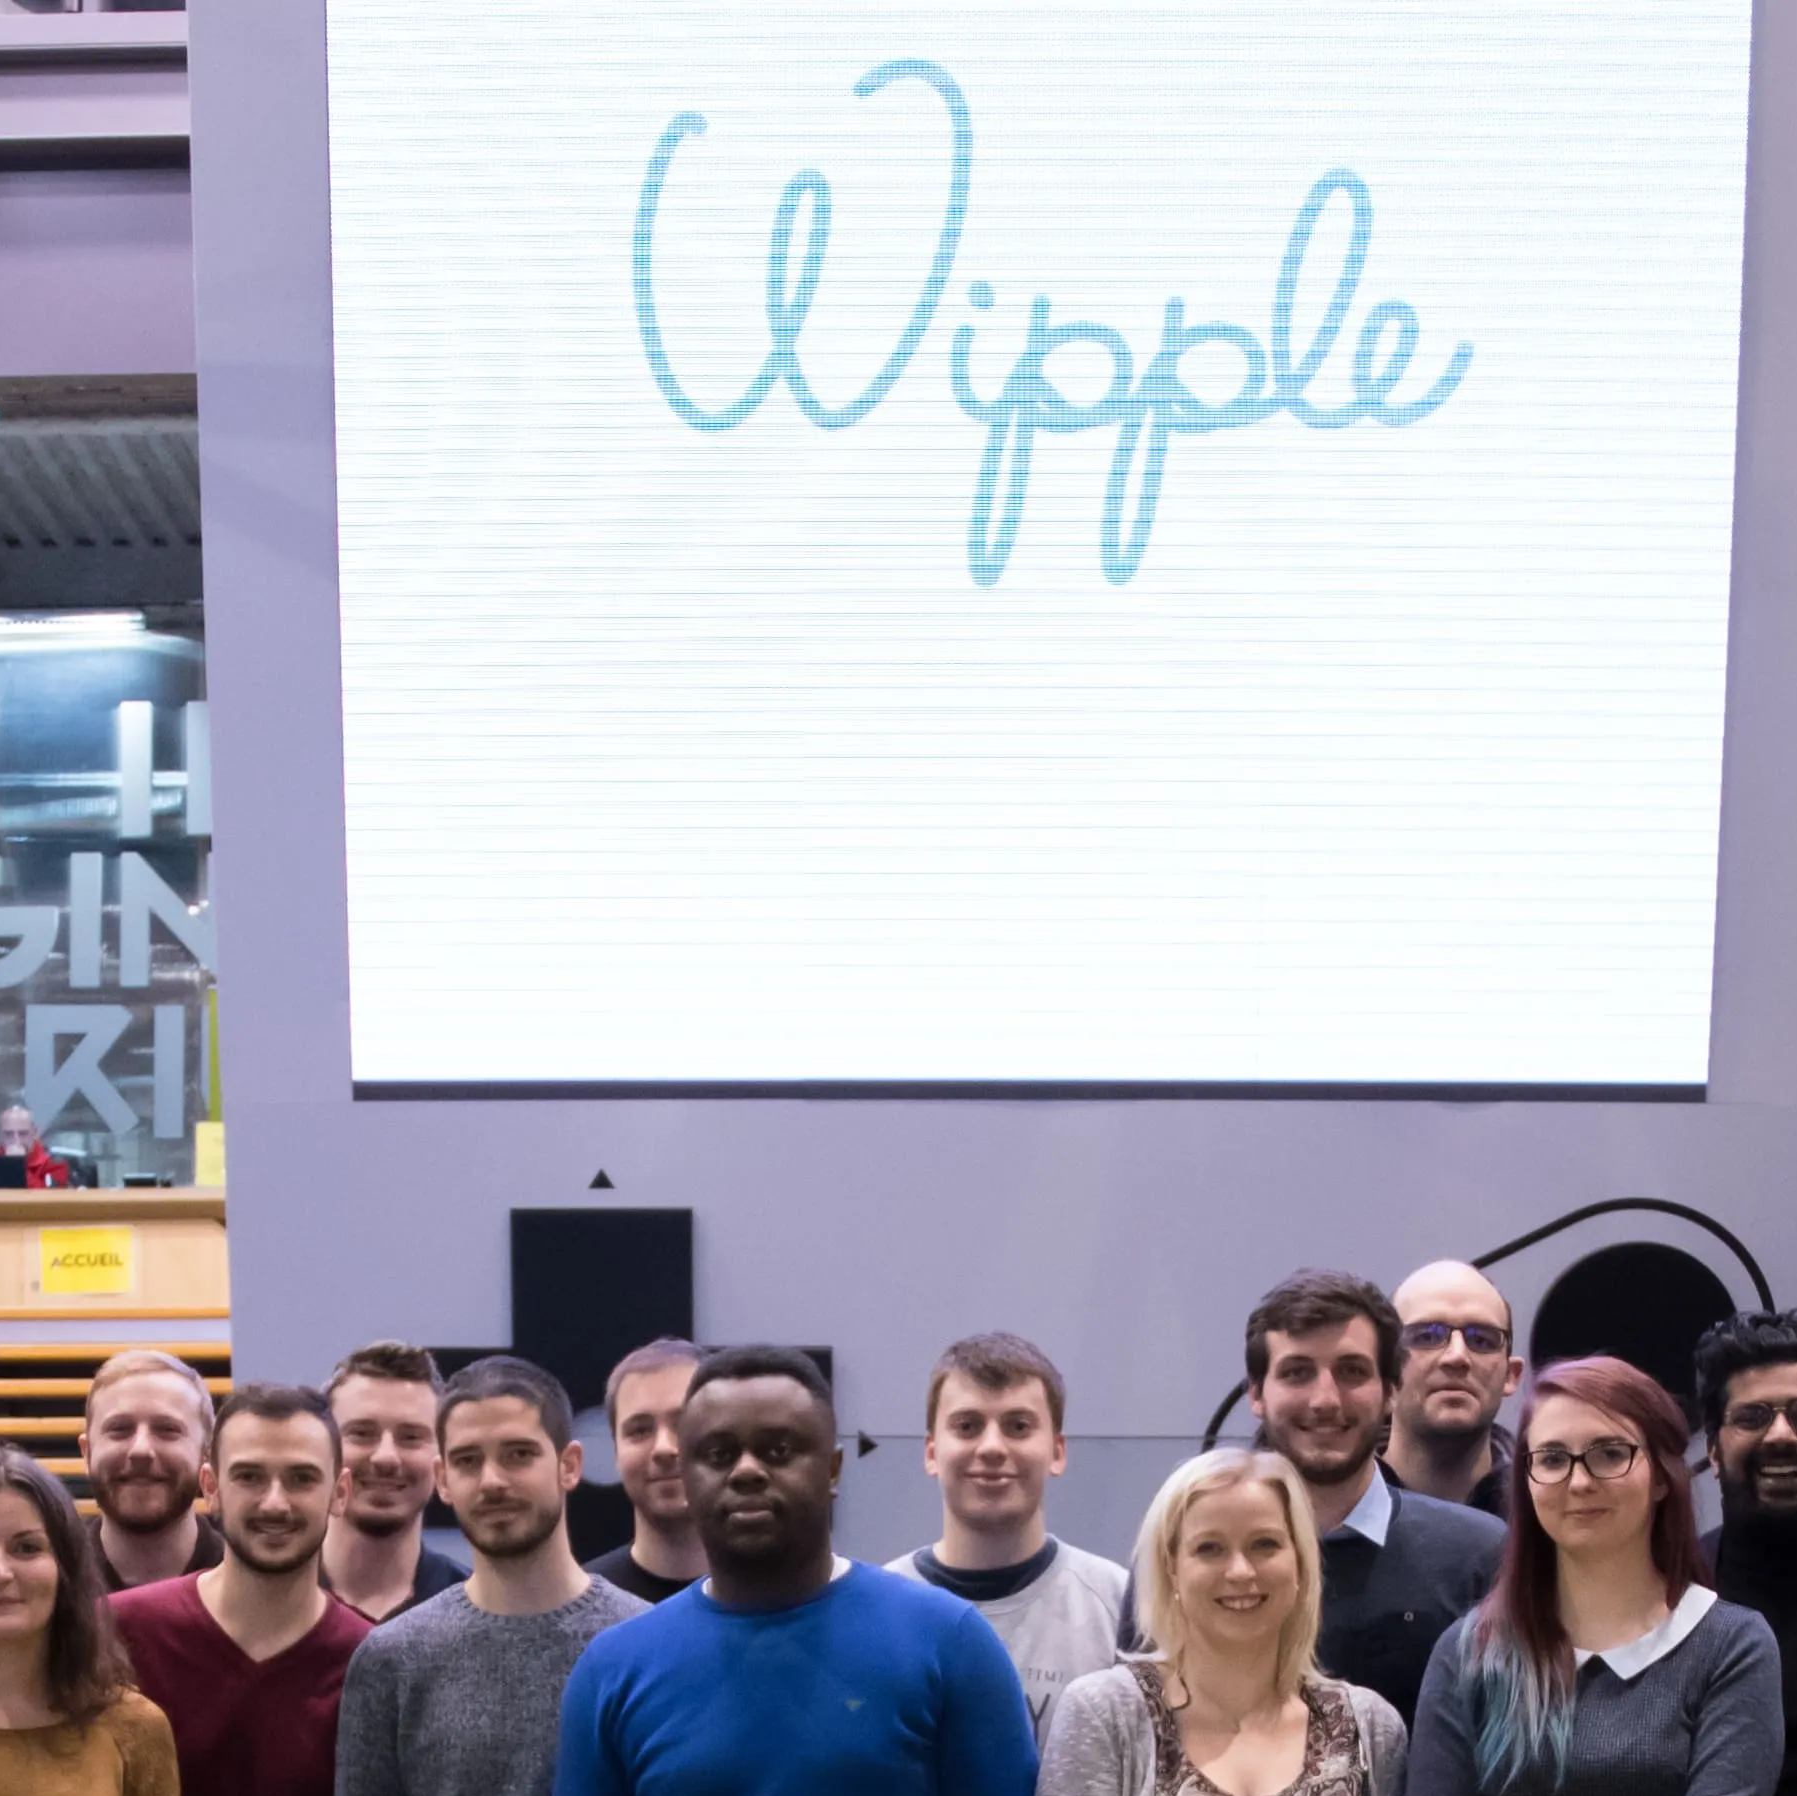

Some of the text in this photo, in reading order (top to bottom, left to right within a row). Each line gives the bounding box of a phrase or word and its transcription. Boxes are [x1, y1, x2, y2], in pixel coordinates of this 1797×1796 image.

[631, 55, 1474, 588] Wipple
[25, 1004, 210, 1140] RI
[51, 1252, 125, 1270] ACCUEIL
